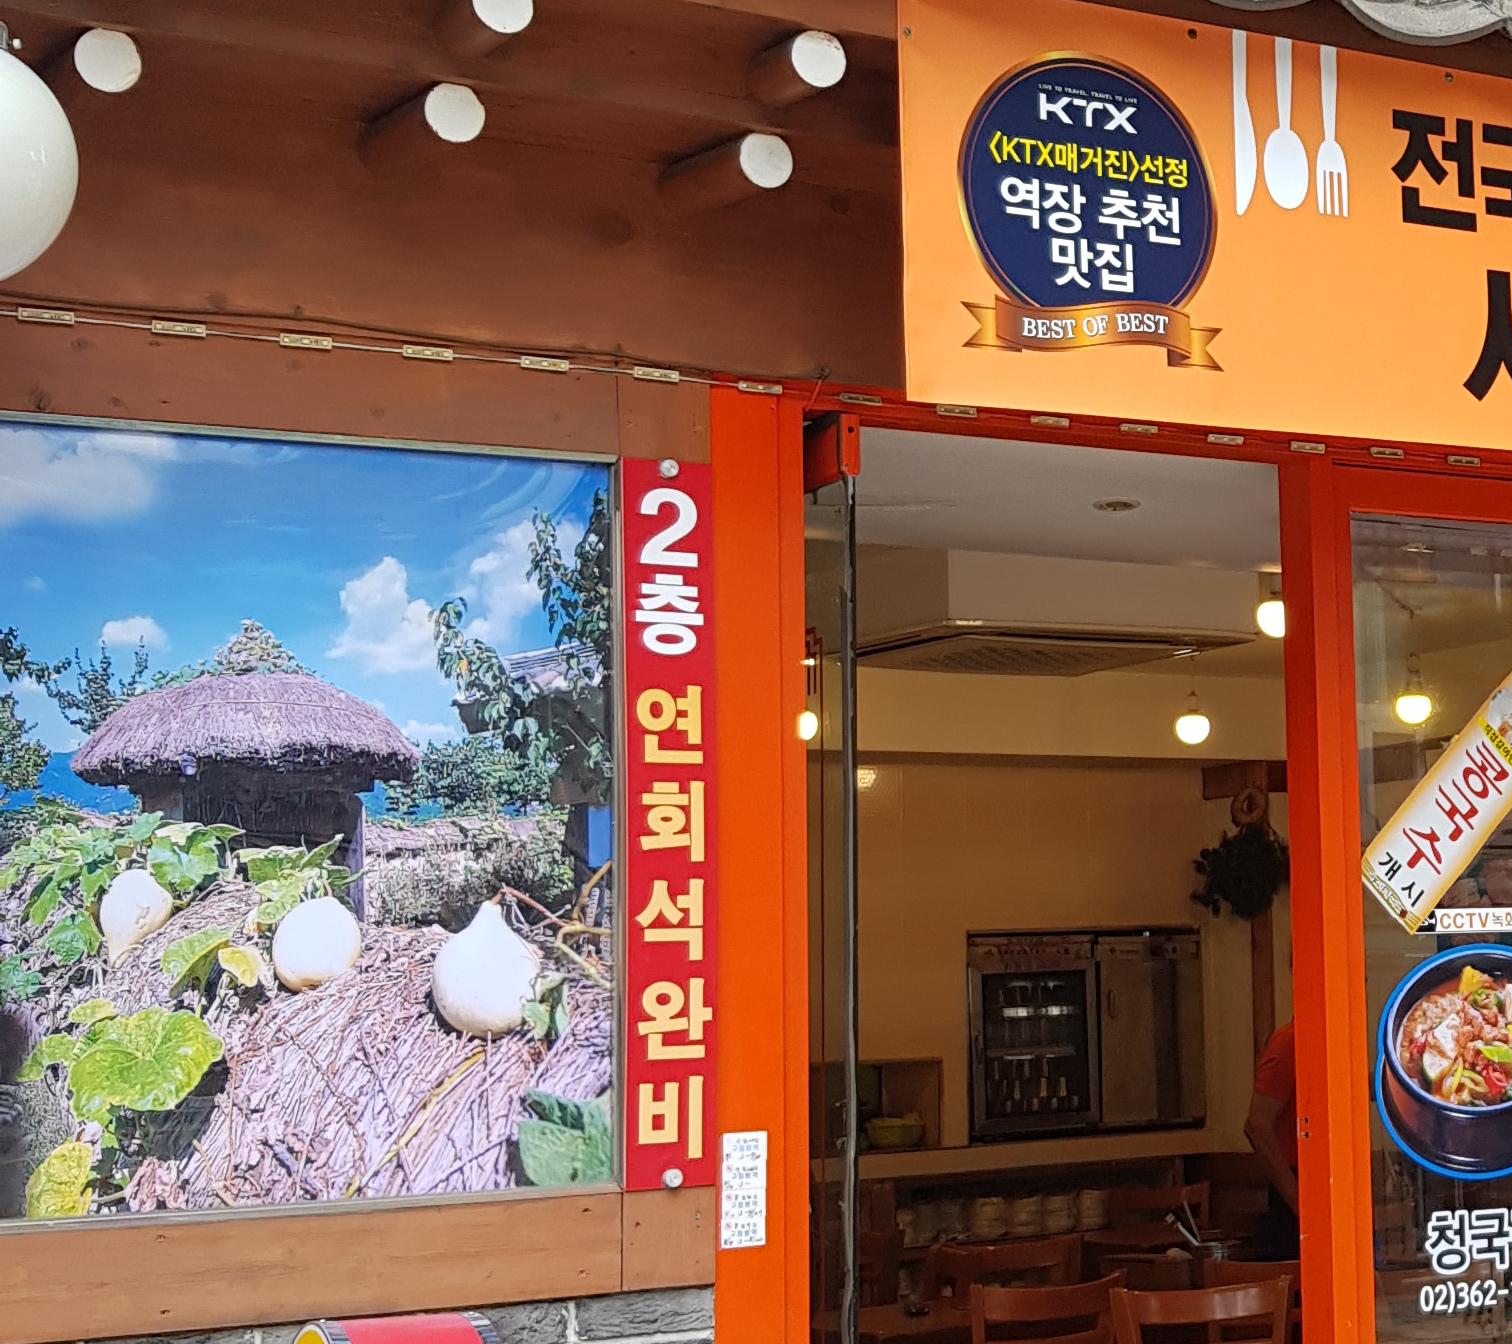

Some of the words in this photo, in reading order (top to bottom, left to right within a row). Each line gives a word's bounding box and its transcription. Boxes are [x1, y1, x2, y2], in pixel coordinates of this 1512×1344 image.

[1039, 92, 1138, 134] KTX
[1000, 176, 1085, 234] 역장
[1099, 189, 1181, 246] 추천
[1050, 236, 1135, 294] 맛집
[1021, 315, 1075, 339] BEST
[1082, 314, 1109, 336] OF
[1115, 312, 1169, 336] BEST
[634, 486, 705, 657] 2층
[635, 683, 708, 963] 연회석
[1403, 740, 1510, 875] 콩국수
[1378, 851, 1425, 908] 개시
[637, 976, 714, 1162] 완비
